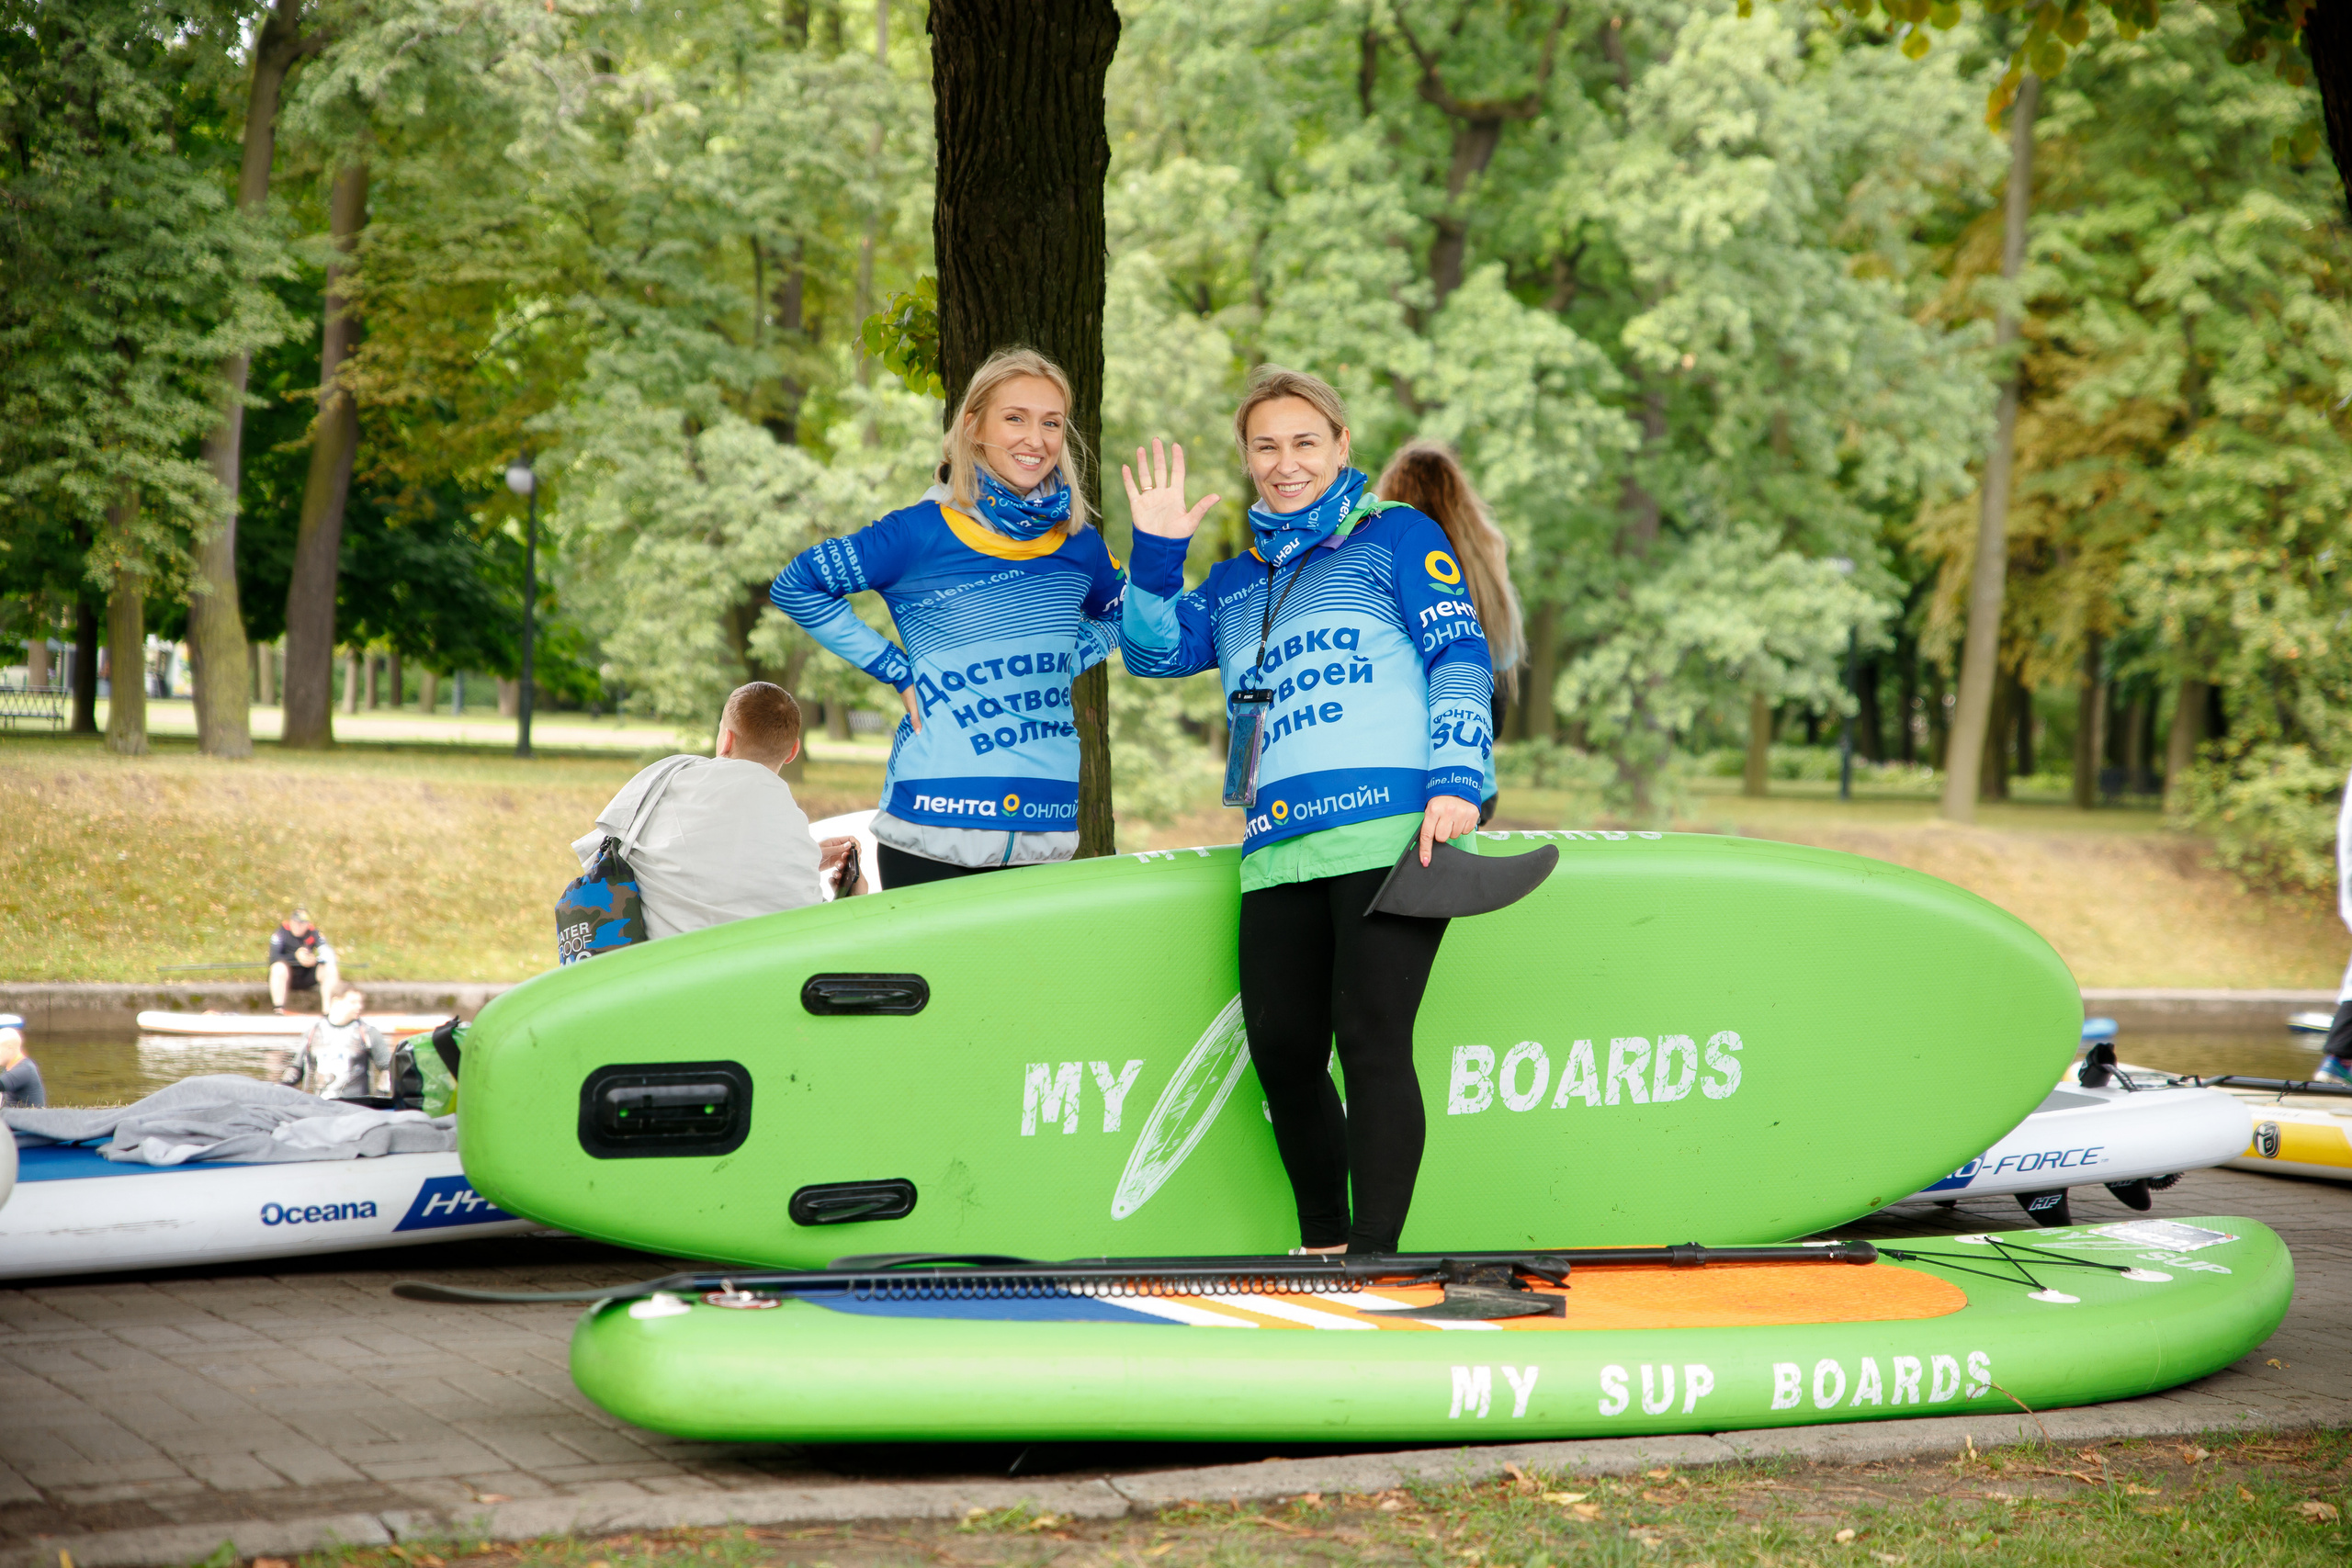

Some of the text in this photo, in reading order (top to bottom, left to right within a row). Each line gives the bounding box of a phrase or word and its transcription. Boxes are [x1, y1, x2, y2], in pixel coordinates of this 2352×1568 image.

[913, 795, 997, 817] лента
[1293, 784, 1390, 820] онлайн
[558, 921, 590, 946] ATER
[1021, 1030, 1744, 1136] MY BOARDS
[260, 1200, 378, 1226] Oceana
[1448, 1350, 1992, 1419] MY SUP BOARDS
